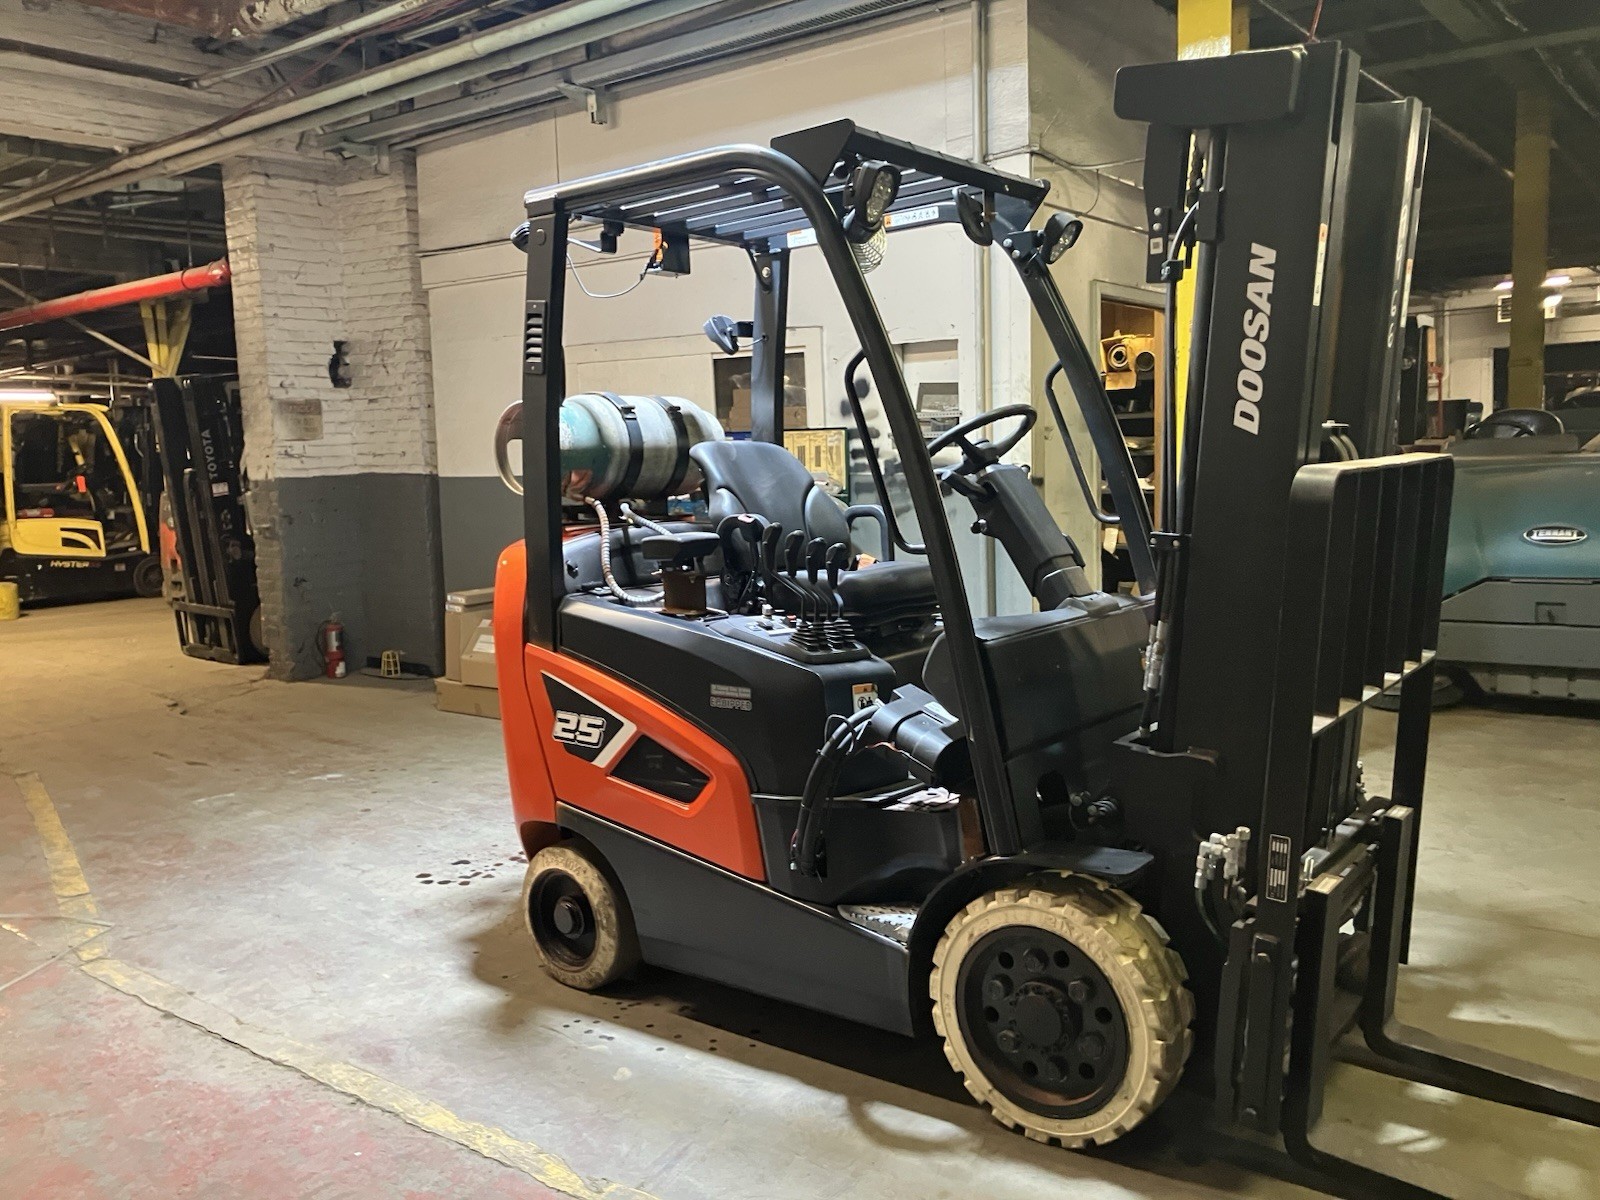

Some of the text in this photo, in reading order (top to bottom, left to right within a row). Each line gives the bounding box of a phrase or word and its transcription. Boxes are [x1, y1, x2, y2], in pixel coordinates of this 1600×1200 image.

[1233, 242, 1277, 435] DOOSAN
[201, 429, 218, 480] TOYOTA
[50, 560, 89, 568] HYSTER
[710, 696, 752, 711] EQUIPPED
[552, 710, 606, 748] 25
